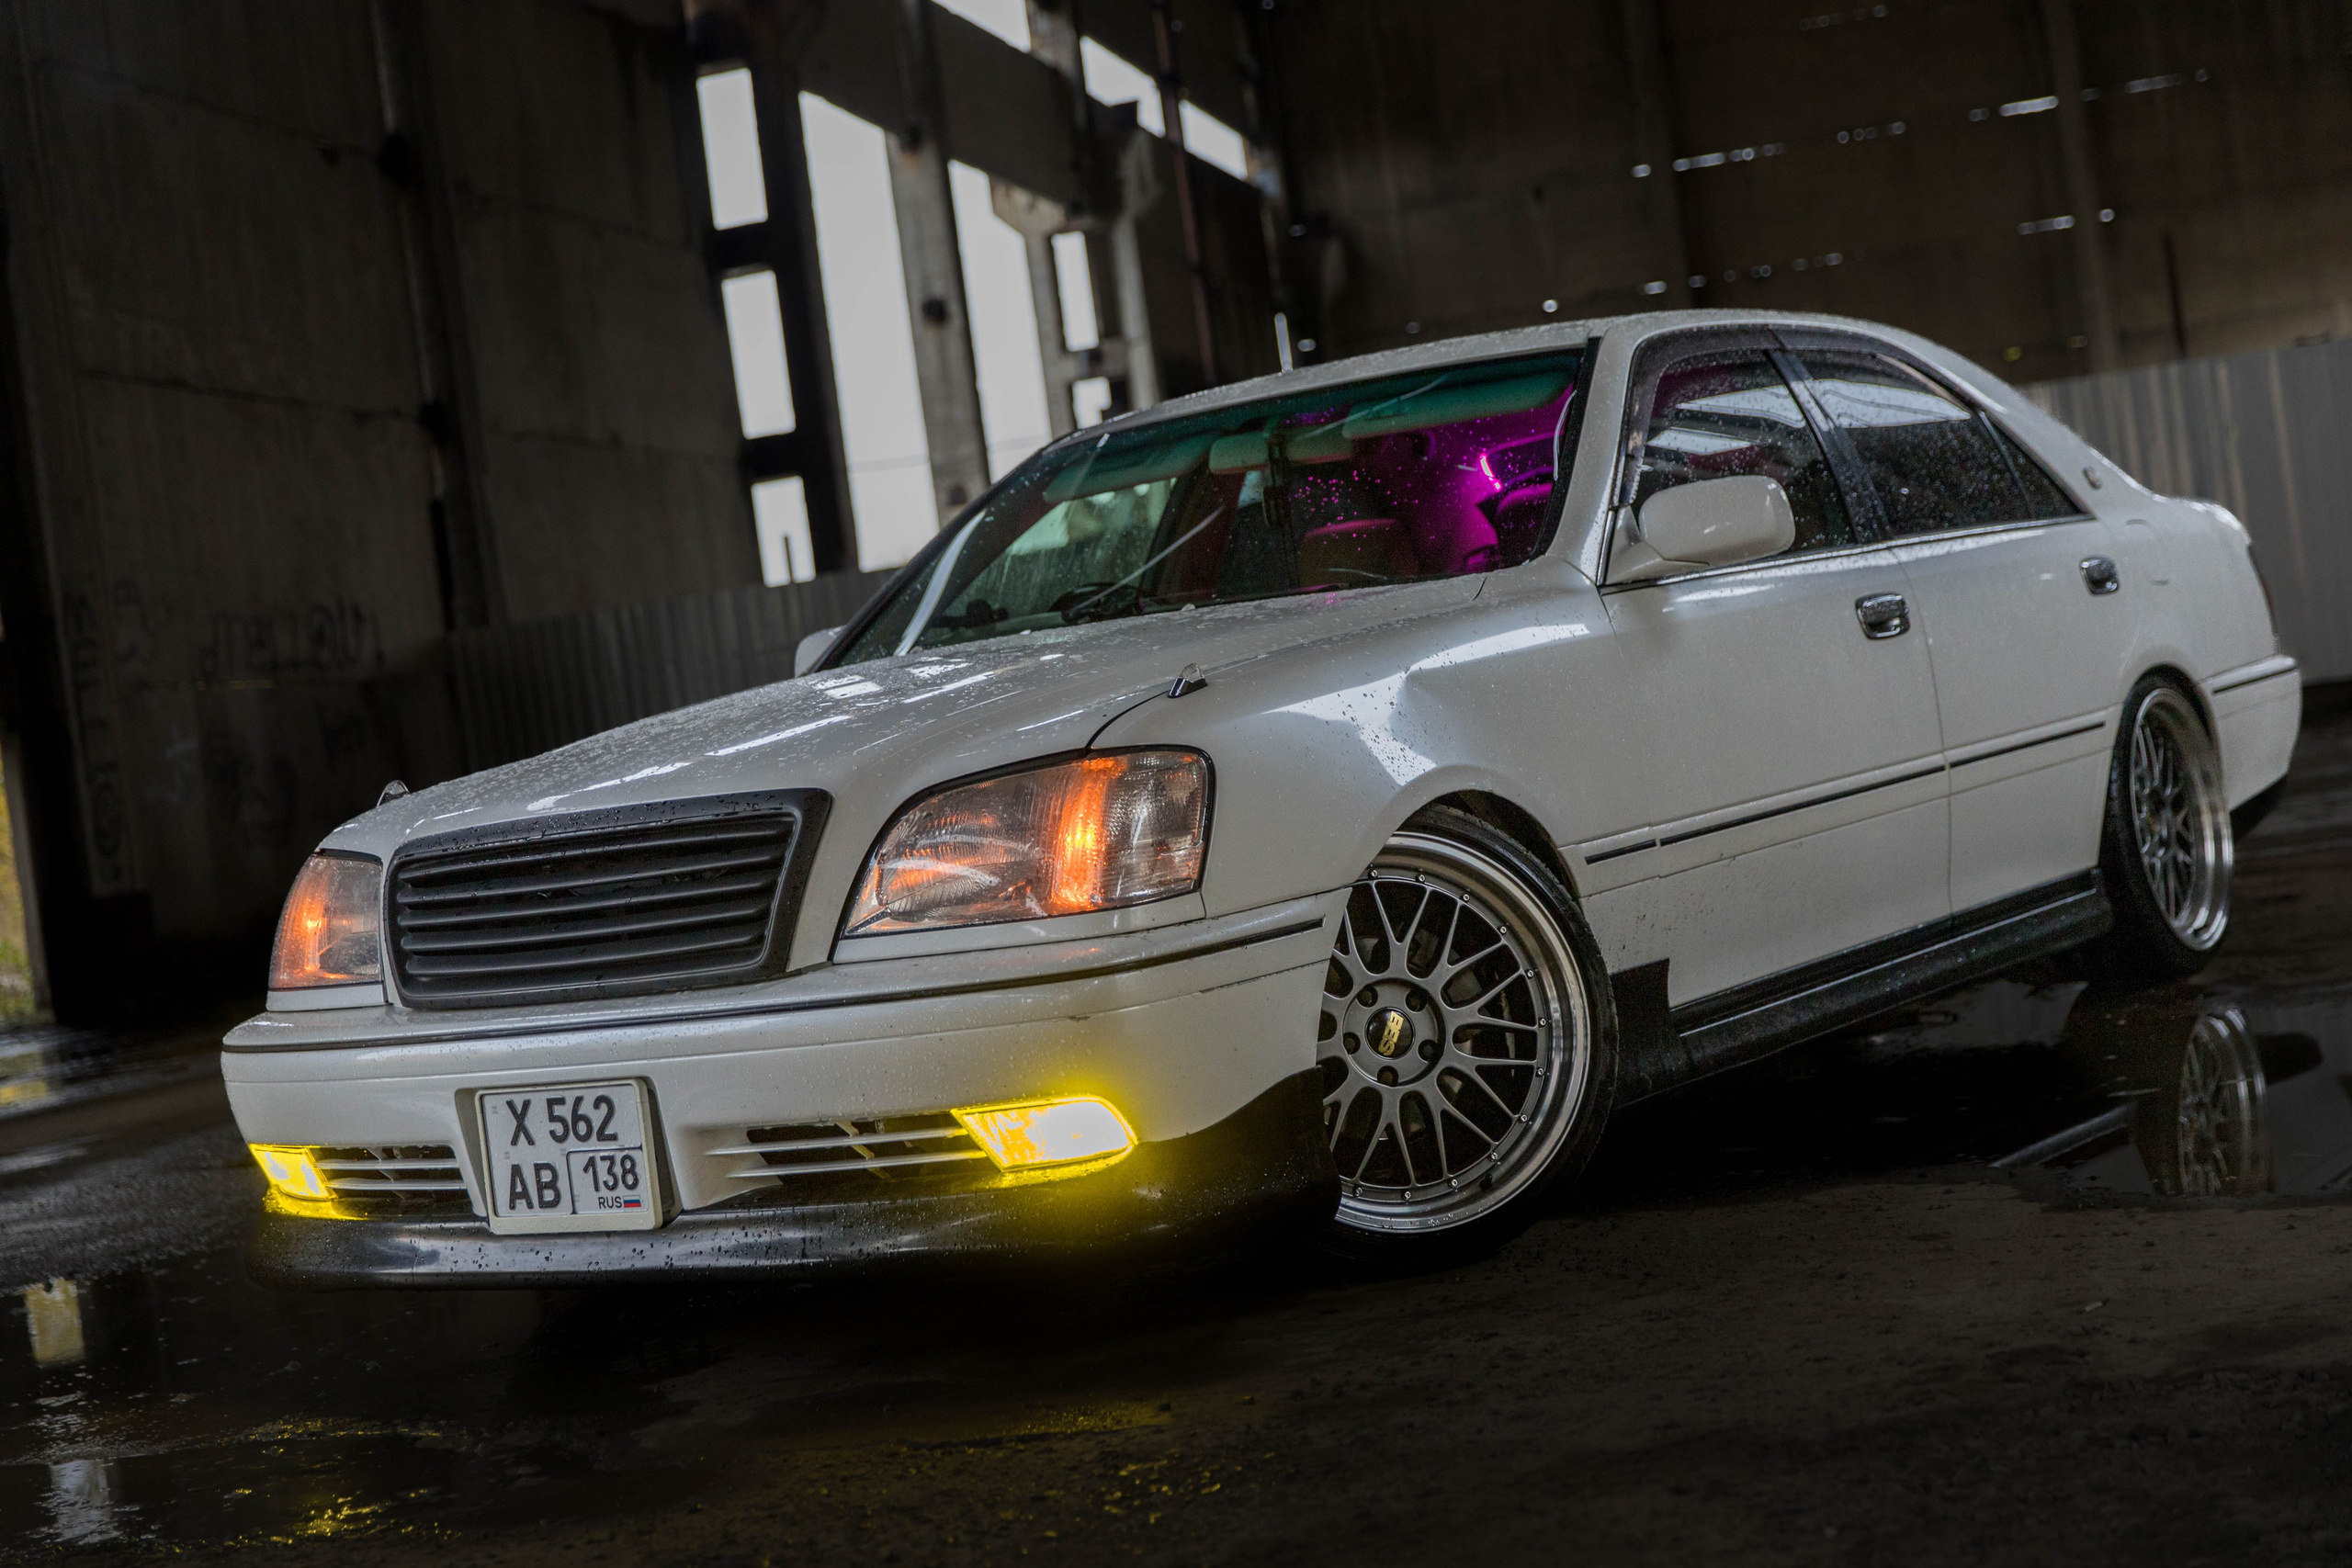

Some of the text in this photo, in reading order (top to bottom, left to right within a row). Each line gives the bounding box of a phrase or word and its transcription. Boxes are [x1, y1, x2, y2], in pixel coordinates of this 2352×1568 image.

[1378, 1010, 1404, 1056] BBS
[546, 1094, 618, 1143] 562
[508, 1162, 562, 1211] AB
[582, 1154, 639, 1193] 138
[598, 1196, 623, 1210] RUS
